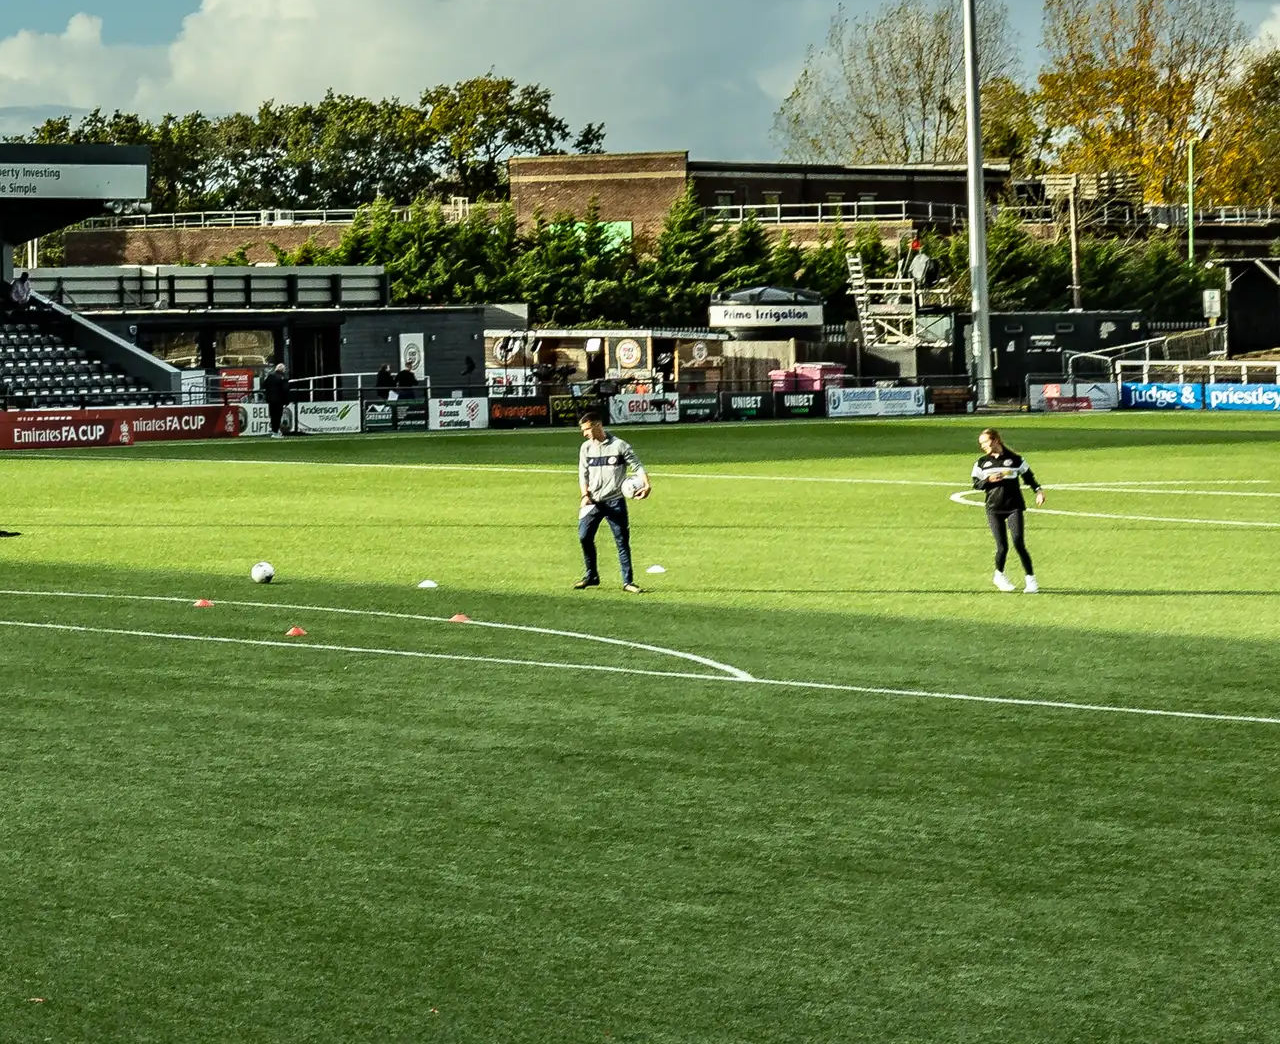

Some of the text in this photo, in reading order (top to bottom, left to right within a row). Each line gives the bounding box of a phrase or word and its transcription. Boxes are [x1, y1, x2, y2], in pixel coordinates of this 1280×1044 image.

[23, 168, 60, 180] Investing
[9, 183, 37, 195] Simple
[724, 308, 808, 322] Prime Irrigation
[784, 394, 814, 406] UNIBET
[1131, 385, 1177, 406] judge
[1180, 386, 1196, 404] &
[731, 396, 762, 409] UNIBET
[299, 405, 339, 415] Anderson
[503, 405, 547, 418] vanarama
[166, 416, 206, 431] FA CUP
[14, 425, 105, 443] Emirates FA CUP
